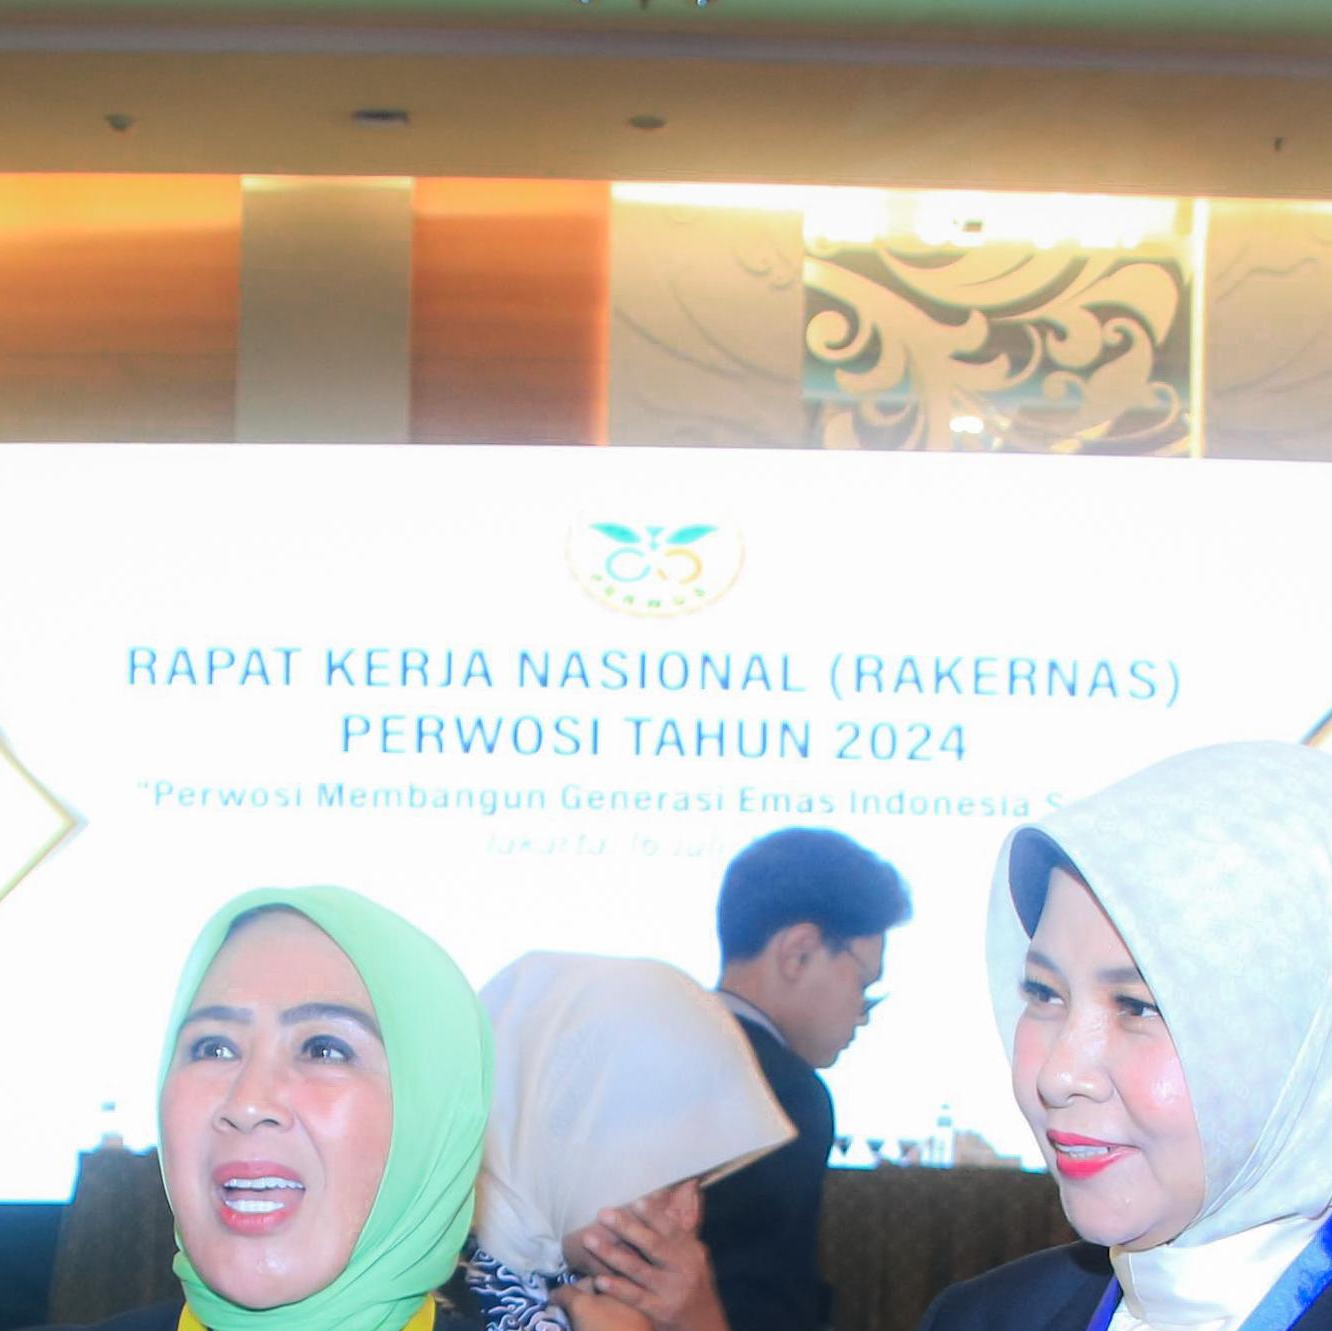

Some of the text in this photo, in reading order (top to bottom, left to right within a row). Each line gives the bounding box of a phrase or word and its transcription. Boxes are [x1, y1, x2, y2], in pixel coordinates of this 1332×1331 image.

[125, 646, 1182, 708] RAPAT KERJA NASIONAL (RAKERNAS)
[340, 714, 967, 763] PERWOSI TAHUN 2024
[317, 782, 548, 816] Membangun
[559, 784, 725, 813] Generasi
[738, 786, 837, 815] Emas
[849, 788, 1031, 817] Indonesia
